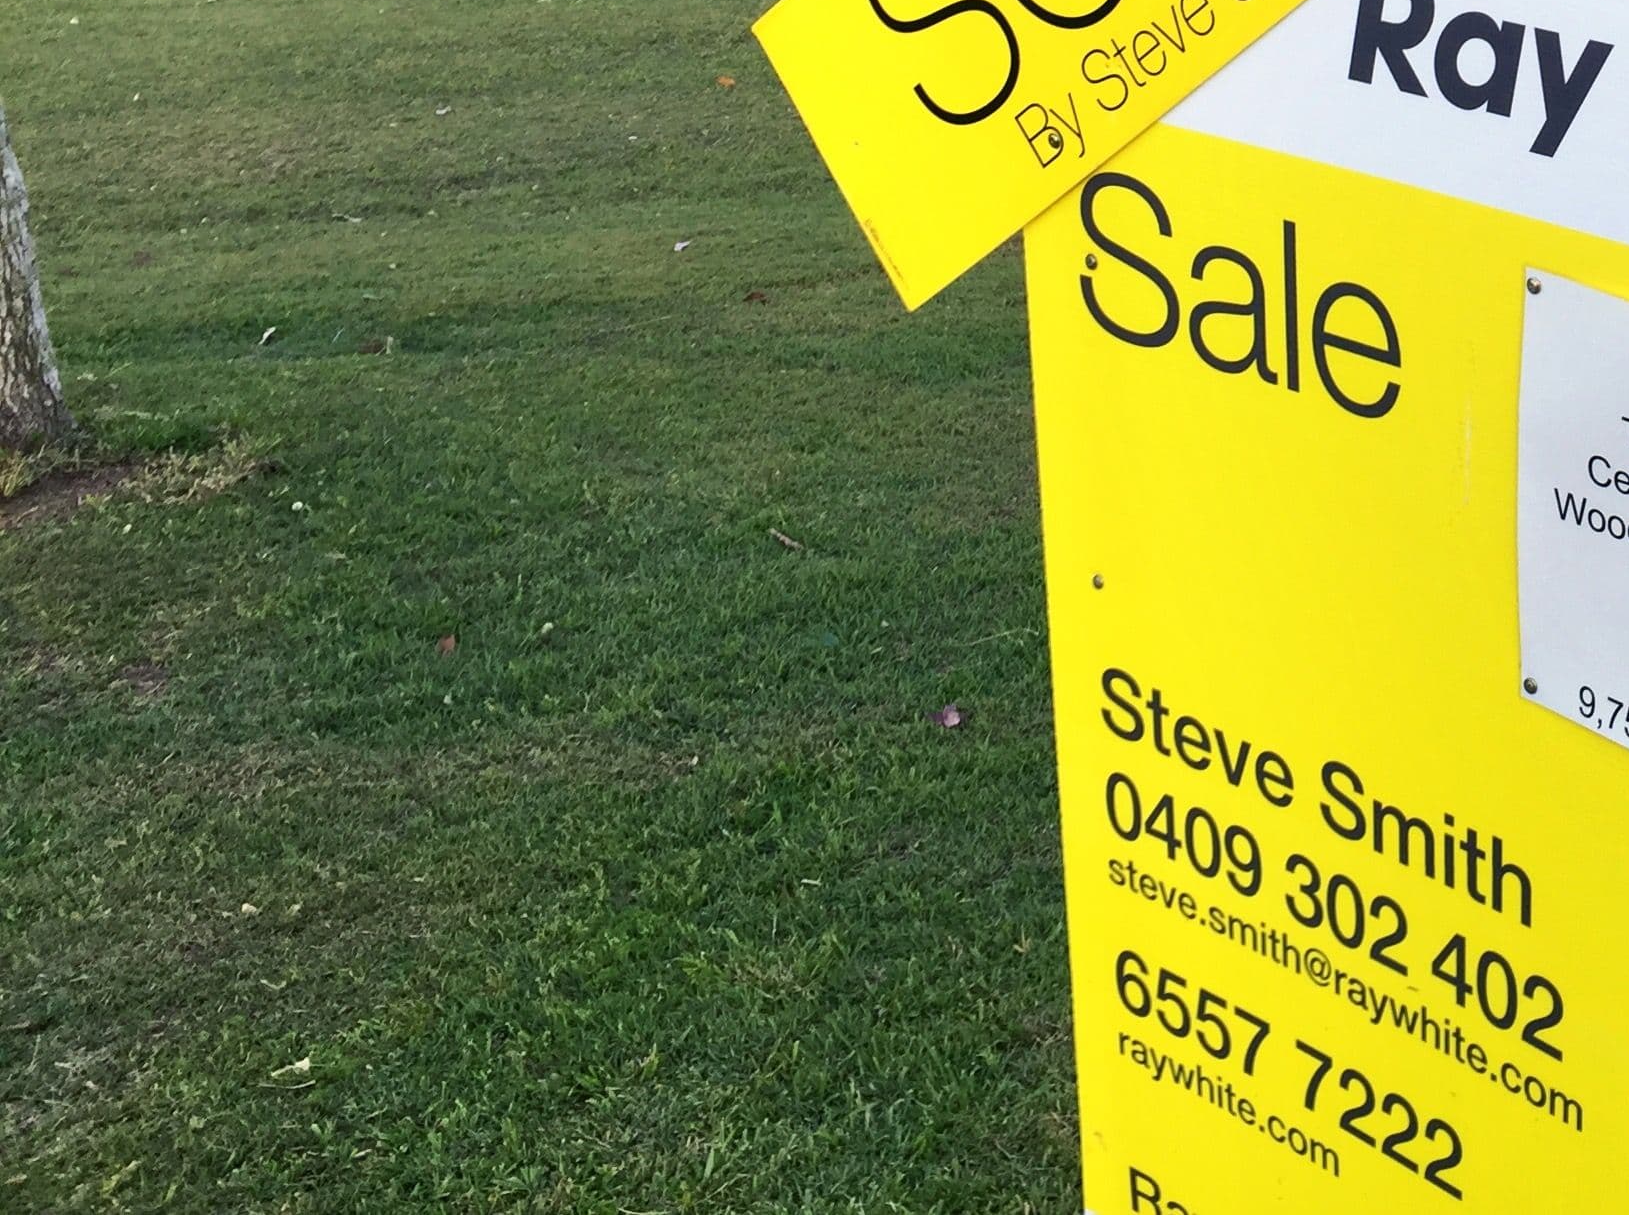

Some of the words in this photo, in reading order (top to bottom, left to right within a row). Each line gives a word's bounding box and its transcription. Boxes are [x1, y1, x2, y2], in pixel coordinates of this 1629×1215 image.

[1015, 93, 1086, 168] By
[1079, 171, 1402, 419] Sale
[1102, 669, 1293, 807] Steve
[1321, 761, 1531, 927] Smith
[1106, 773, 1261, 896] 0409
[1286, 854, 1407, 976] 302
[1432, 934, 1563, 1061] 402
[1109, 860, 1582, 1131] steve.smith@raywhite.com
[1116, 951, 1269, 1075] 6557
[1296, 1040, 1462, 1200] 7222
[1120, 1034, 1338, 1176] raywhite.com
